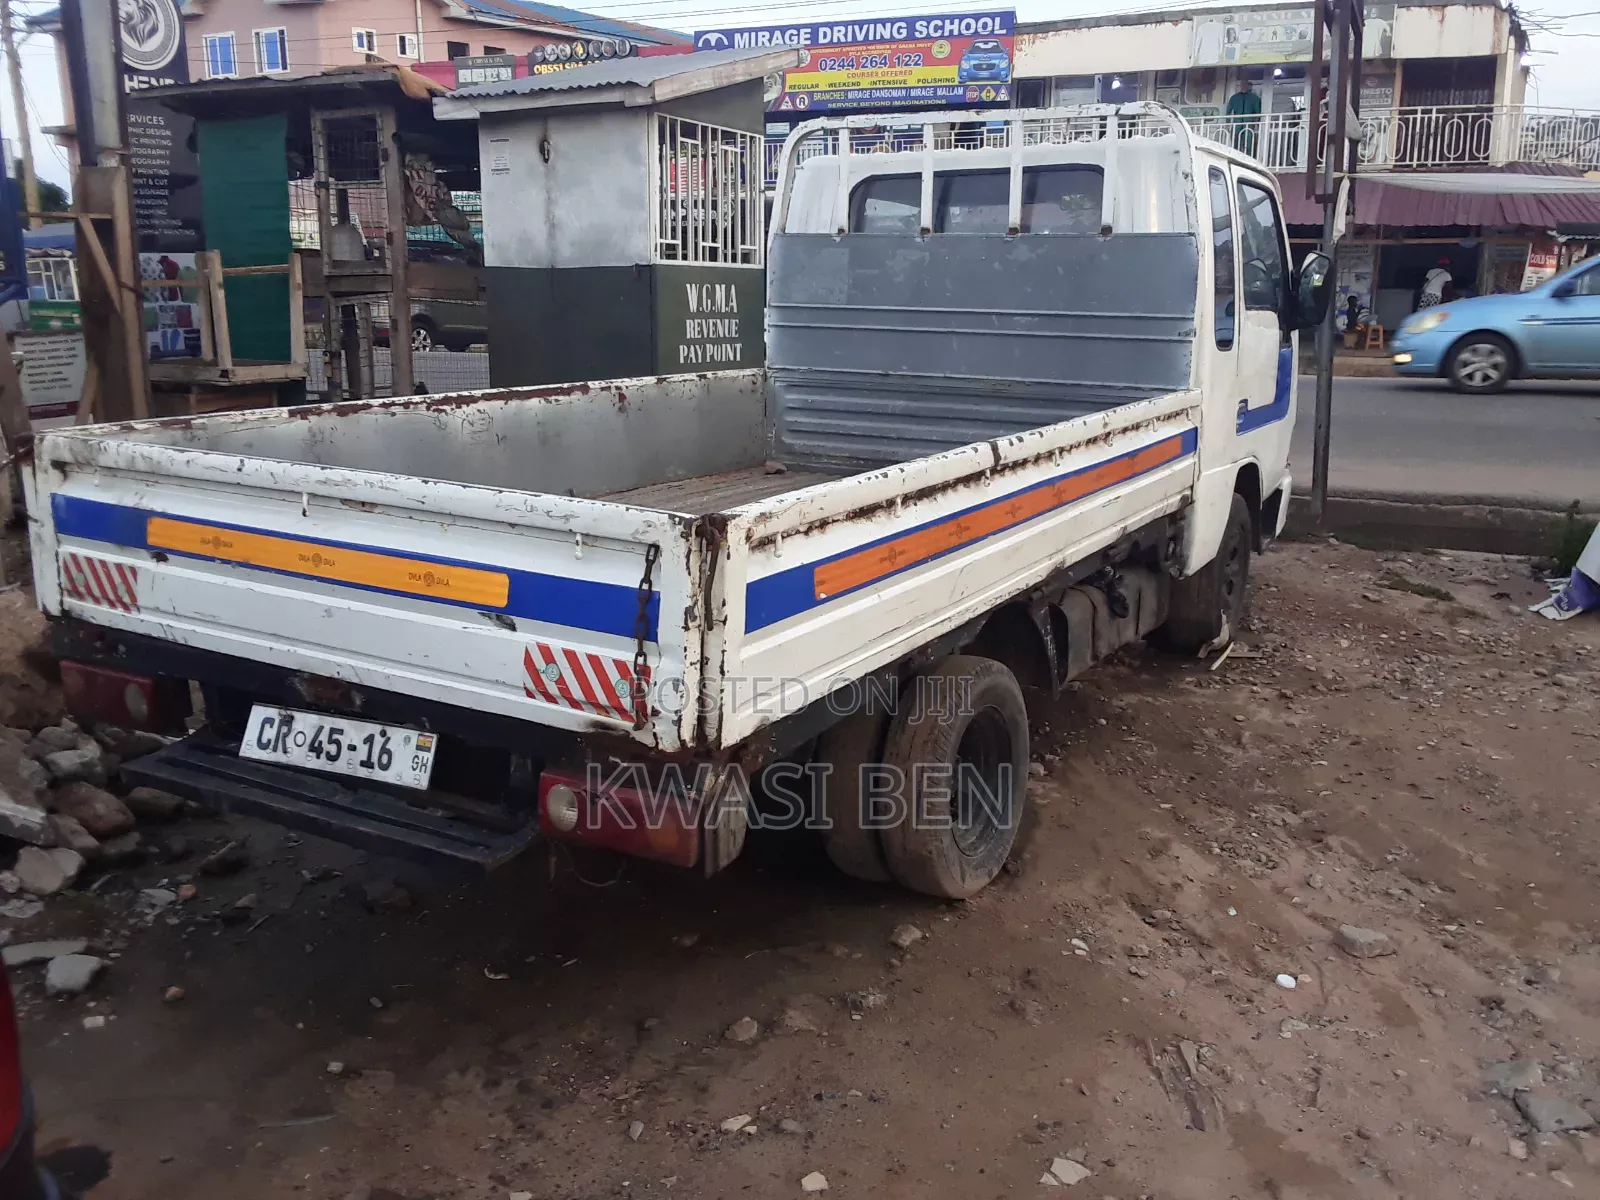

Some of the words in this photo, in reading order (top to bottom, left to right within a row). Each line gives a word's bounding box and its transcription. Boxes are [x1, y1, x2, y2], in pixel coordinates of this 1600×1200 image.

[734, 28, 812, 50] MIRAGE
[818, 21, 908, 44] DRIVING
[914, 17, 1007, 38] SCHOOL
[818, 57, 856, 72] 0244
[859, 54, 889, 70] 264
[894, 52, 923, 68] 122
[788, 83, 820, 91] REGULAR
[827, 81, 861, 89] WEEKEND
[869, 79, 908, 87] INTENSIVE
[916, 77, 956, 85] POLISHING
[846, 71, 879, 79] COURSES
[880, 69, 913, 77] OFFERED
[813, 91, 847, 101] BRANCHES:
[847, 90, 871, 100] MIRAGE
[910, 87, 934, 97] MIRAGE
[936, 86, 964, 96] MALLAM
[685, 318, 740, 340] REVENUE
[678, 343, 704, 364] PAY
[704, 342, 743, 363] POINT
[256, 716, 294, 754] CR
[411, 754, 430, 775] GH
